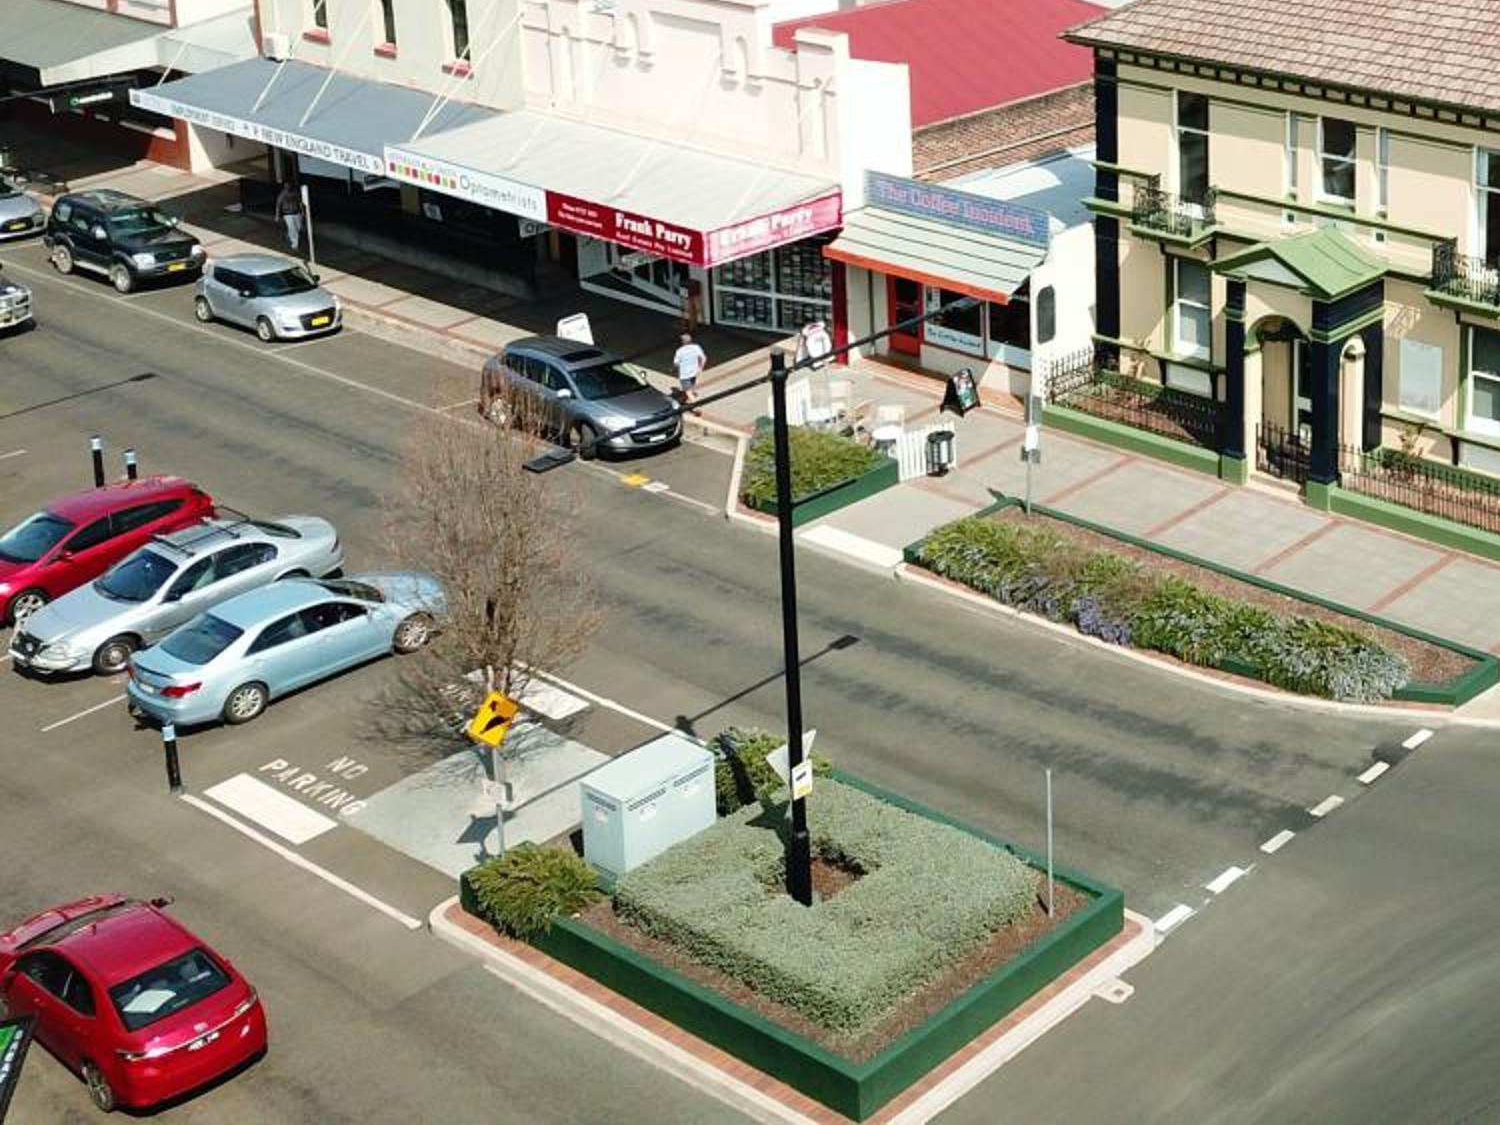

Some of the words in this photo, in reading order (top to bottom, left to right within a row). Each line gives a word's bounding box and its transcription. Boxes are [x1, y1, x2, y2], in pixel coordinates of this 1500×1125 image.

[261, 128, 284, 144] NEW
[284, 134, 333, 157] ENGLAND
[333, 146, 370, 168] TRAVEL
[459, 174, 539, 211] Optometrists
[615, 211, 653, 238] Frank
[325, 756, 369, 780] NO
[258, 758, 368, 816] PARKING
